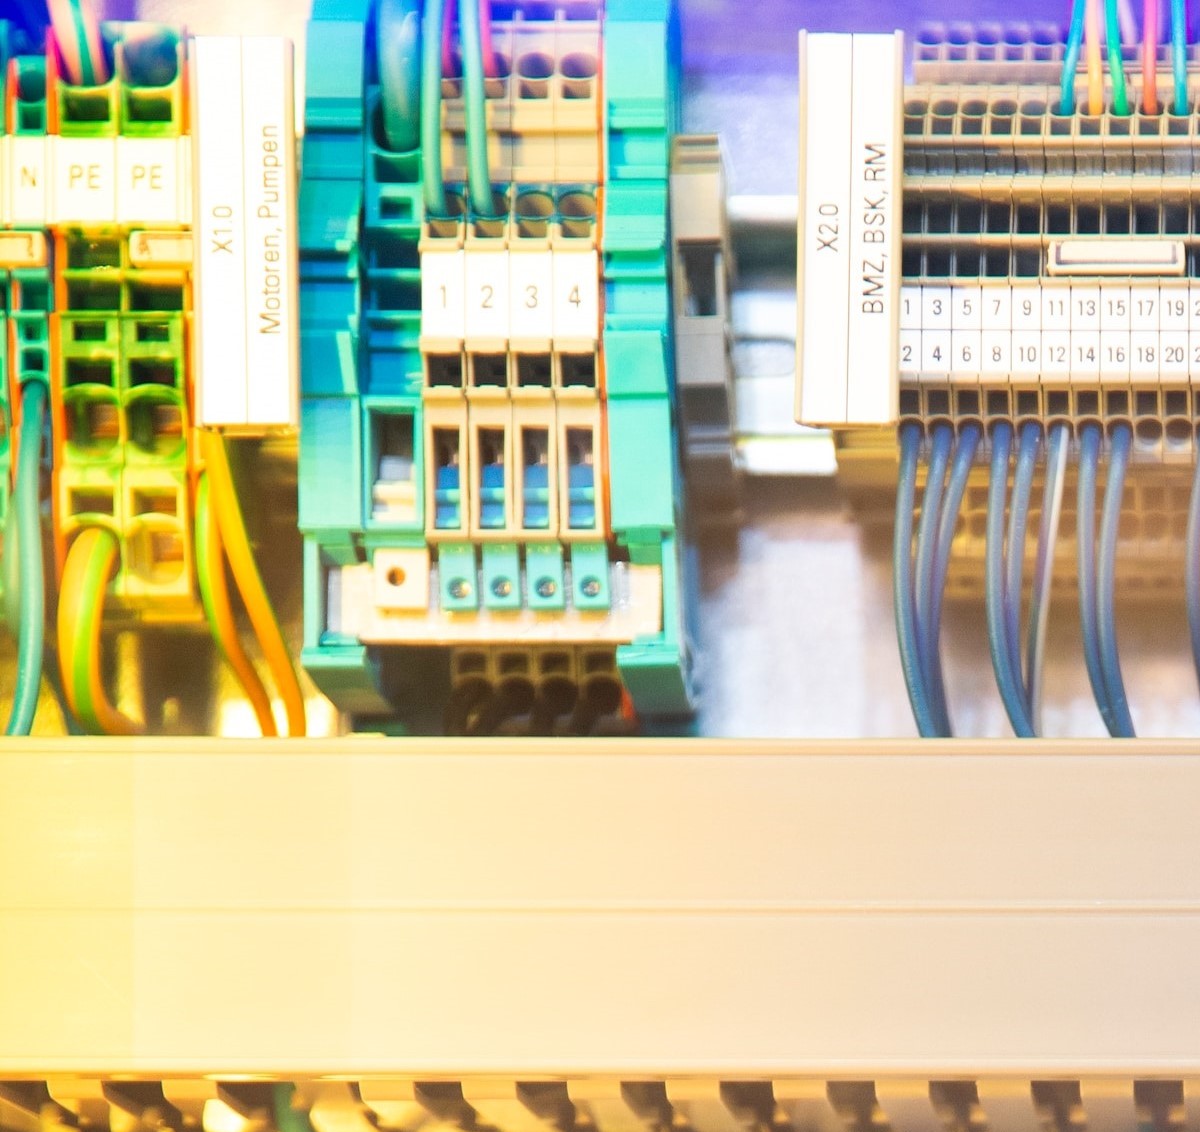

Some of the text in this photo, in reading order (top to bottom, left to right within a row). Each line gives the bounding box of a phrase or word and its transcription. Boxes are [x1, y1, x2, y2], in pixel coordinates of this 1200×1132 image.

[20, 164, 163, 190] N PE PE
[211, 205, 233, 254] X1.0
[257, 124, 283, 335] Motoren, Pumpen
[816, 204, 839, 253] X2.0
[862, 143, 888, 315] BMZ, BSK, RM
[439, 284, 582, 309] 1 2 3 4
[904, 298, 910, 315] 1
[932, 299, 942, 316] 3
[962, 299, 972, 316] 5
[992, 299, 1001, 316] 7
[1022, 299, 1032, 316] 9
[1048, 299, 1064, 316] 11
[1078, 299, 1096, 317] 13
[1107, 299, 1126, 317] 15
[1137, 299, 1155, 316] 17
[1167, 299, 1185, 317] 19
[902, 345, 912, 362] 2
[932, 346, 942, 362] 4
[962, 345, 972, 362] 6
[992, 346, 1002, 362] 8
[1019, 346, 1037, 363] 10
[1048, 346, 1066, 363] 12
[1078, 346, 1096, 363] 14
[1107, 346, 1126, 363] 16
[1137, 346, 1155, 363] 18
[1165, 346, 1185, 363] 20
